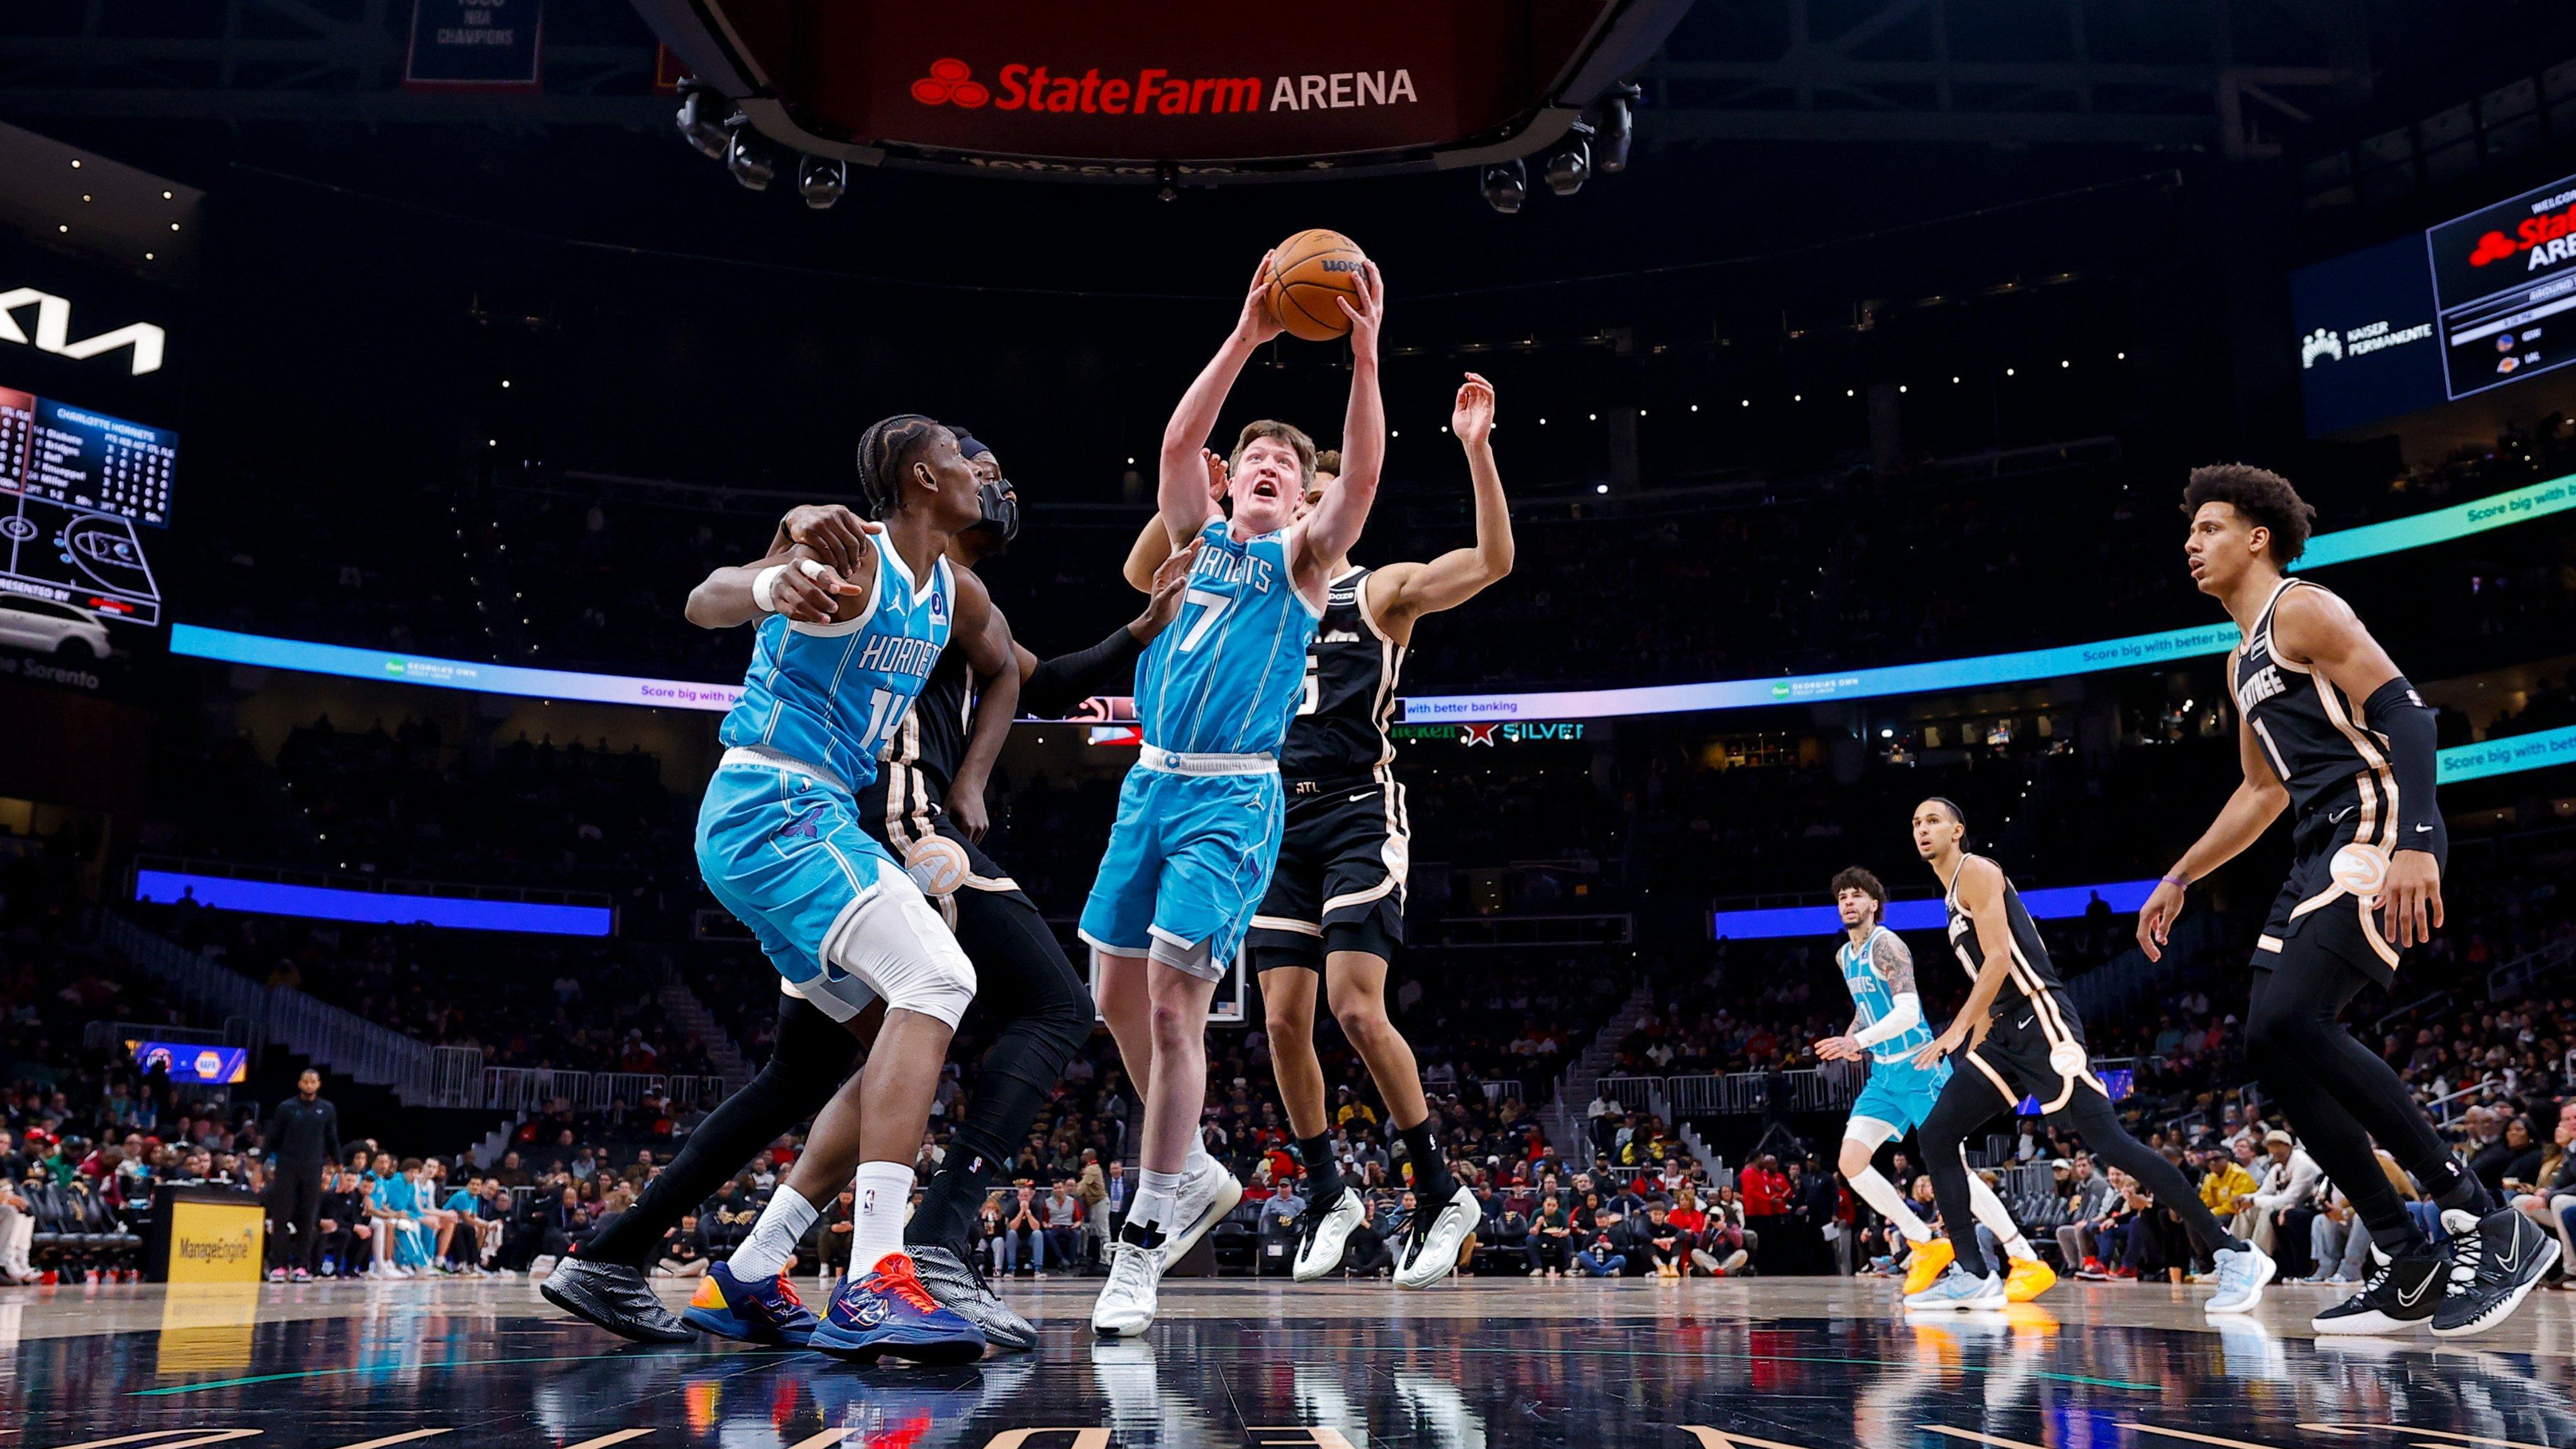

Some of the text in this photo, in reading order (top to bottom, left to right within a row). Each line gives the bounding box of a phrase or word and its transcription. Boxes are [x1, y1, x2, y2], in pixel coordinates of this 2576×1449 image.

[1269, 69, 1418, 112] ARENA
[2346, 321, 2389, 343] KAISER
[2348, 323, 2433, 357] PERMANENTE
[57, 408, 155, 442] CHARLOTTE HORNETS
[2468, 504, 2506, 522] Score
[2509, 497, 2532, 511] big
[2534, 487, 2565, 504] with
[1329, 592, 1355, 600] paze
[1178, 589, 1233, 652] 7
[2083, 650, 2118, 661] Score
[2122, 644, 2141, 657] big
[2146, 640, 2172, 652] with
[2175, 635, 2214, 648] better
[21, 657, 100, 689] Sorento
[455, 668, 477, 677] OWN
[1793, 680, 1836, 691] GEORGIA'S
[1839, 678, 1858, 686] OWN
[641, 685, 674, 697] Score
[678, 689, 696, 701] big
[700, 691, 724, 701] with
[860, 689, 916, 751] 14
[1407, 701, 1518, 714] with better banking
[2252, 716, 2292, 782] 1
[2443, 755, 2484, 771] Score
[2487, 748, 2510, 763] big
[2513, 742, 2546, 757] with
[1296, 782, 1320, 794] ATL
[180, 1238, 247, 1264] ManageEngine
